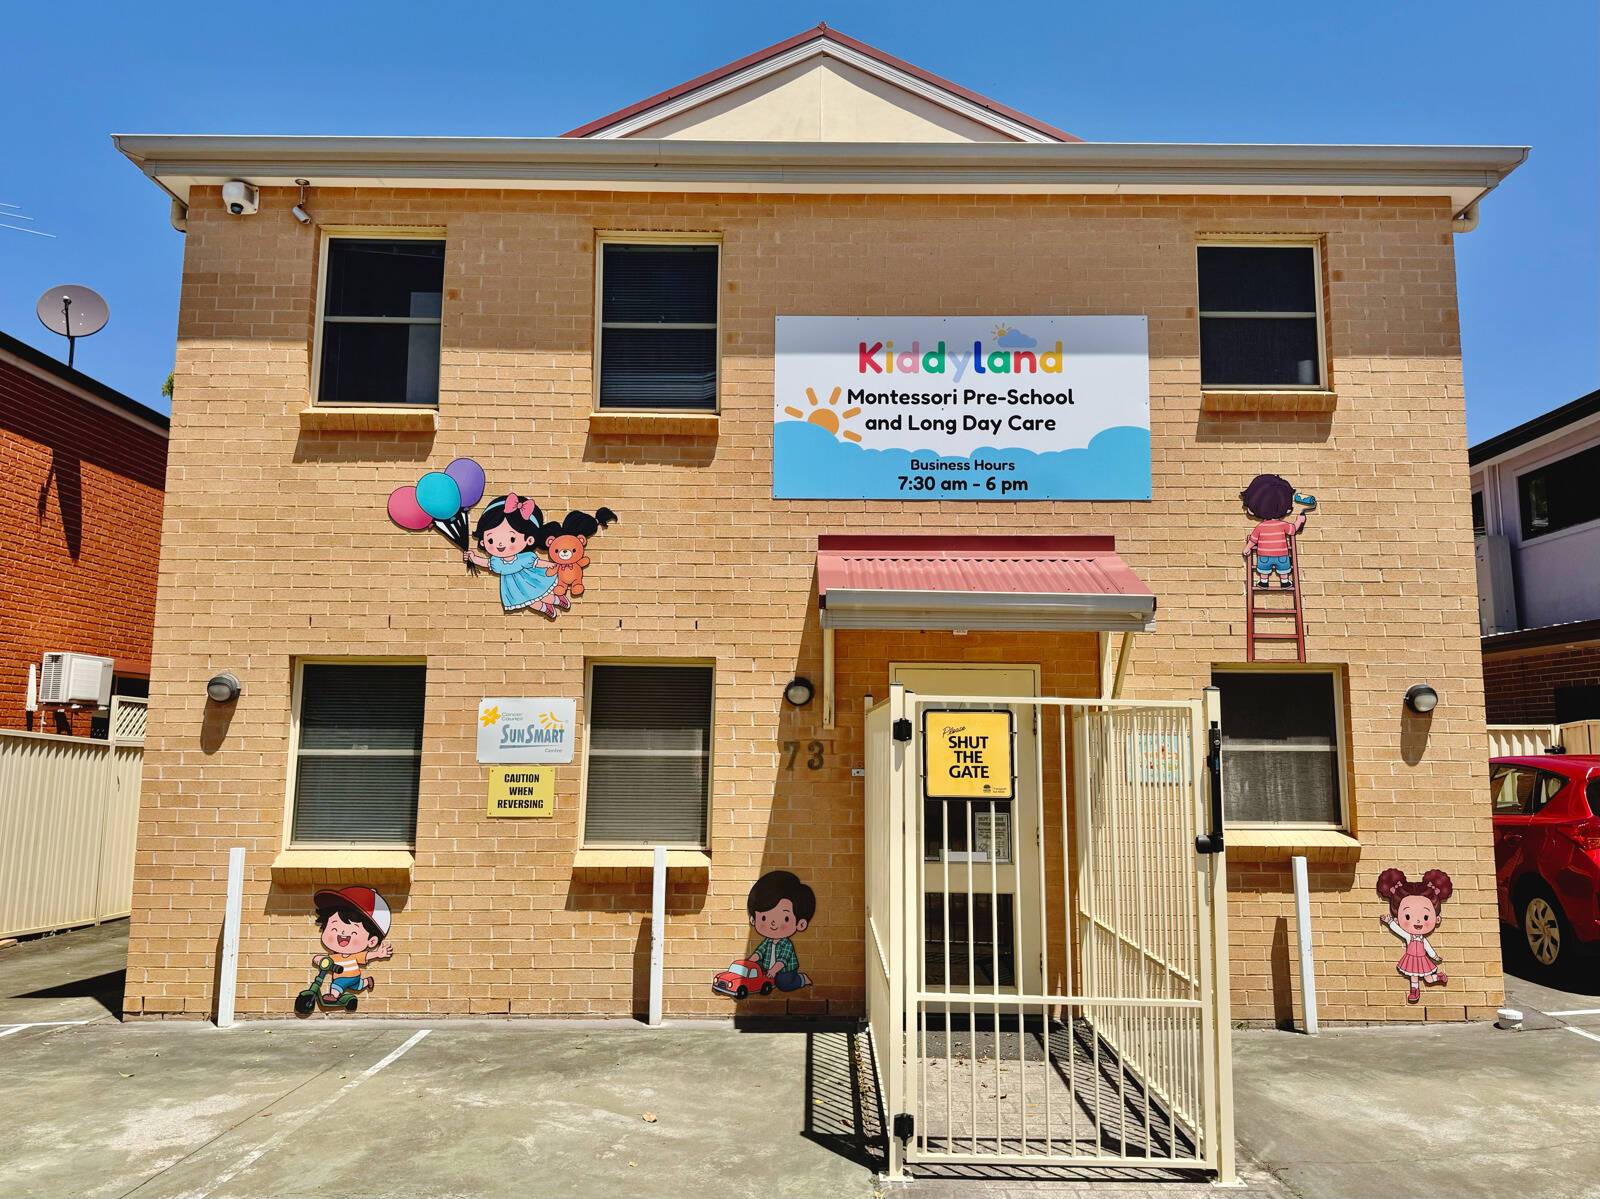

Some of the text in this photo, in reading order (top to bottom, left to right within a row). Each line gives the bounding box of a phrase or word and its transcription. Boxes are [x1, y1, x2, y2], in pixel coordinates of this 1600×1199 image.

[858, 340, 1064, 384] Kiddyland
[847, 388, 1075, 406] Montessori Pre-School
[864, 414, 1057, 435] and Long Day Care
[910, 459, 1016, 471] Business Hours
[898, 476, 936, 491] 7:30
[940, 479, 968, 491] am
[985, 476, 996, 491] 6
[1001, 479, 1029, 495] pm
[942, 725, 967, 738] Please
[948, 735, 989, 749] SHUT
[783, 741, 825, 771] 73
[953, 750, 984, 764] THE
[504, 773, 540, 783] CAUTION
[948, 765, 990, 779] GATE
[509, 786, 534, 796] WHEN
[497, 799, 544, 809] REVERSING
